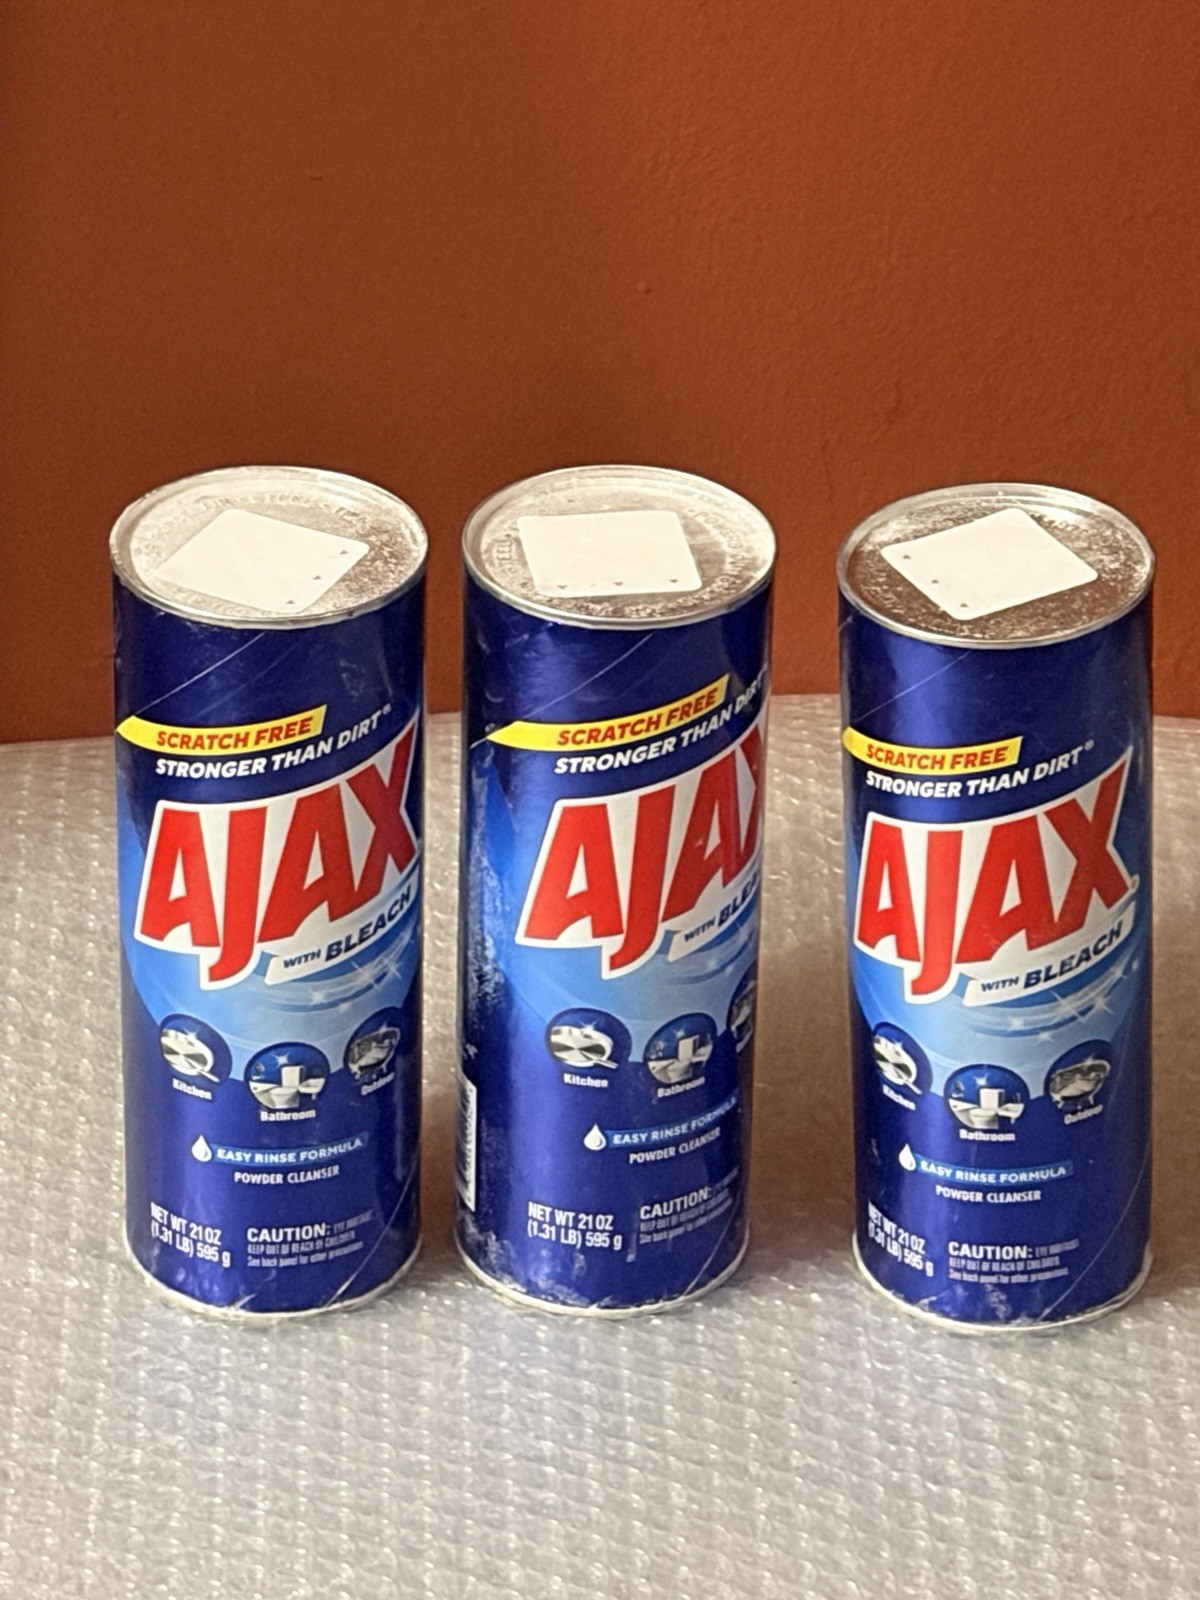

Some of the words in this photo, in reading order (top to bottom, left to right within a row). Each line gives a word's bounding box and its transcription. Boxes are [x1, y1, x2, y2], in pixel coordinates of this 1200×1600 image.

[556, 712, 660, 747] SCRATCH
[664, 687, 718, 727] FREE
[156, 728, 251, 750] SCRATCH
[254, 716, 314, 746] FREE
[554, 737, 677, 775] STRONGER
[680, 703, 733, 748] THAN
[155, 757, 266, 778] STRONGER
[271, 737, 332, 770] THAN
[866, 743, 945, 770] SCRATCH
[949, 746, 1010, 771] FREE
[866, 770, 962, 798] STRONGER
[966, 768, 1030, 796] THAN
[138, 718, 418, 985] AJAX
[856, 757, 1131, 997] AJAX
[283, 948, 321, 969] WITH
[325, 886, 412, 961] BLEACH
[980, 975, 1019, 993] WITH
[1023, 918, 1124, 989] BLEACH
[172, 1078, 213, 1101] Kitchen
[563, 1072, 609, 1089] Kitchen
[260, 1109, 316, 1122] Bathroom
[613, 1133, 649, 1145] EASY
[651, 1122, 689, 1141] RINSE
[628, 1146, 676, 1165] POWDER
[678, 1126, 721, 1155] CLEANSER
[959, 1129, 1016, 1142] Bathroom
[216, 1147, 252, 1162] EASY
[254, 1151, 296, 1164] RINSE
[300, 1137, 362, 1162] FORMULA
[234, 1171, 283, 1185] POWDER
[287, 1165, 340, 1183] CLEANSER
[920, 1159, 952, 1178] EASY
[955, 1170, 997, 1183] RINSE
[999, 1166, 1067, 1183] FORMULA
[640, 1185, 712, 1220] CAUTION:
[935, 1185, 983, 1203] POWDER
[986, 1189, 1042, 1204] CLEANSER
[150, 1201, 169, 1226] NET
[170, 1213, 188, 1235] WT
[528, 1201, 552, 1223] NET
[554, 1209, 576, 1228] WT
[247, 1222, 331, 1243] CAUTION:
[527, 1219, 556, 1242] (1.31
[560, 1227, 582, 1250] LB)
[585, 1231, 611, 1248] 595
[613, 1234, 623, 1251] g
[196, 1242, 219, 1262] 595
[948, 1241, 1033, 1260] CAUTION:
